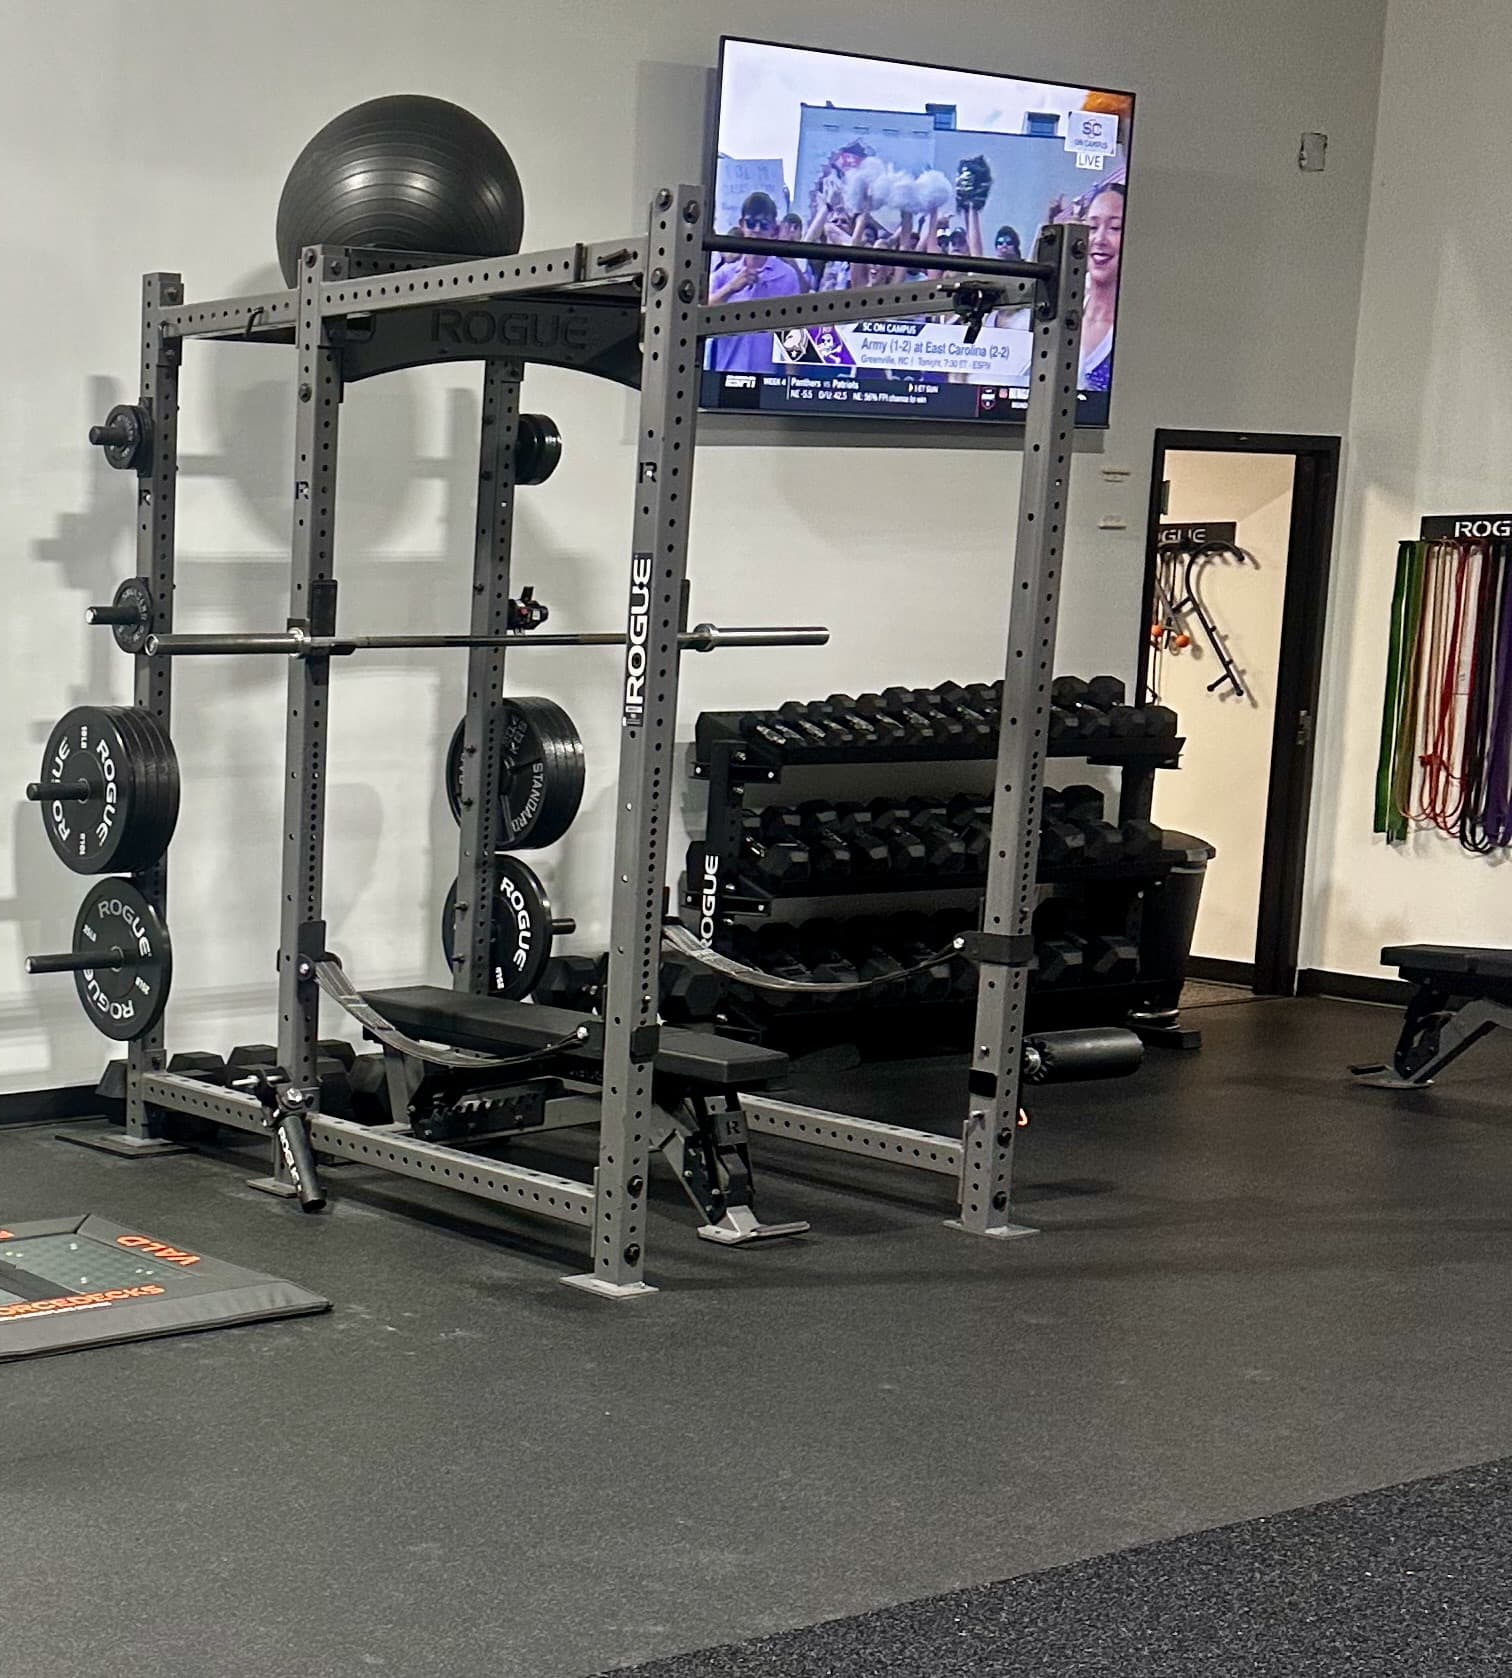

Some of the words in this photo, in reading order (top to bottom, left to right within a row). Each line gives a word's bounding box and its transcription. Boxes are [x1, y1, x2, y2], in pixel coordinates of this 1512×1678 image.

[1082, 121, 1103, 136] SC
[1078, 152, 1102, 168] LIVE
[431, 309, 587, 349] ROGUE
[862, 322, 873, 332] SC
[874, 323, 886, 333] ON
[886, 324, 917, 334] CAMPUS
[861, 337, 887, 351] Army
[890, 338, 912, 353] (1-2)
[914, 341, 923, 352] at
[925, 341, 946, 354] East
[948, 343, 987, 358] Carolina
[989, 344, 1010, 360] (2-2)
[725, 374, 756, 388] ESPN
[763, 377, 780, 386] WEEK
[791, 377, 821, 388] Panthers
[832, 378, 859, 389] Patriots
[626, 557, 652, 704] ROGUE
[51, 737, 71, 841] ROUE
[96, 739, 117, 847] ROGUE
[511, 762, 544, 832] STANDARD
[98, 899, 151, 957] ROGUE
[500, 876, 531, 971] ROGUE
[115, 1236, 201, 1265] VALD
